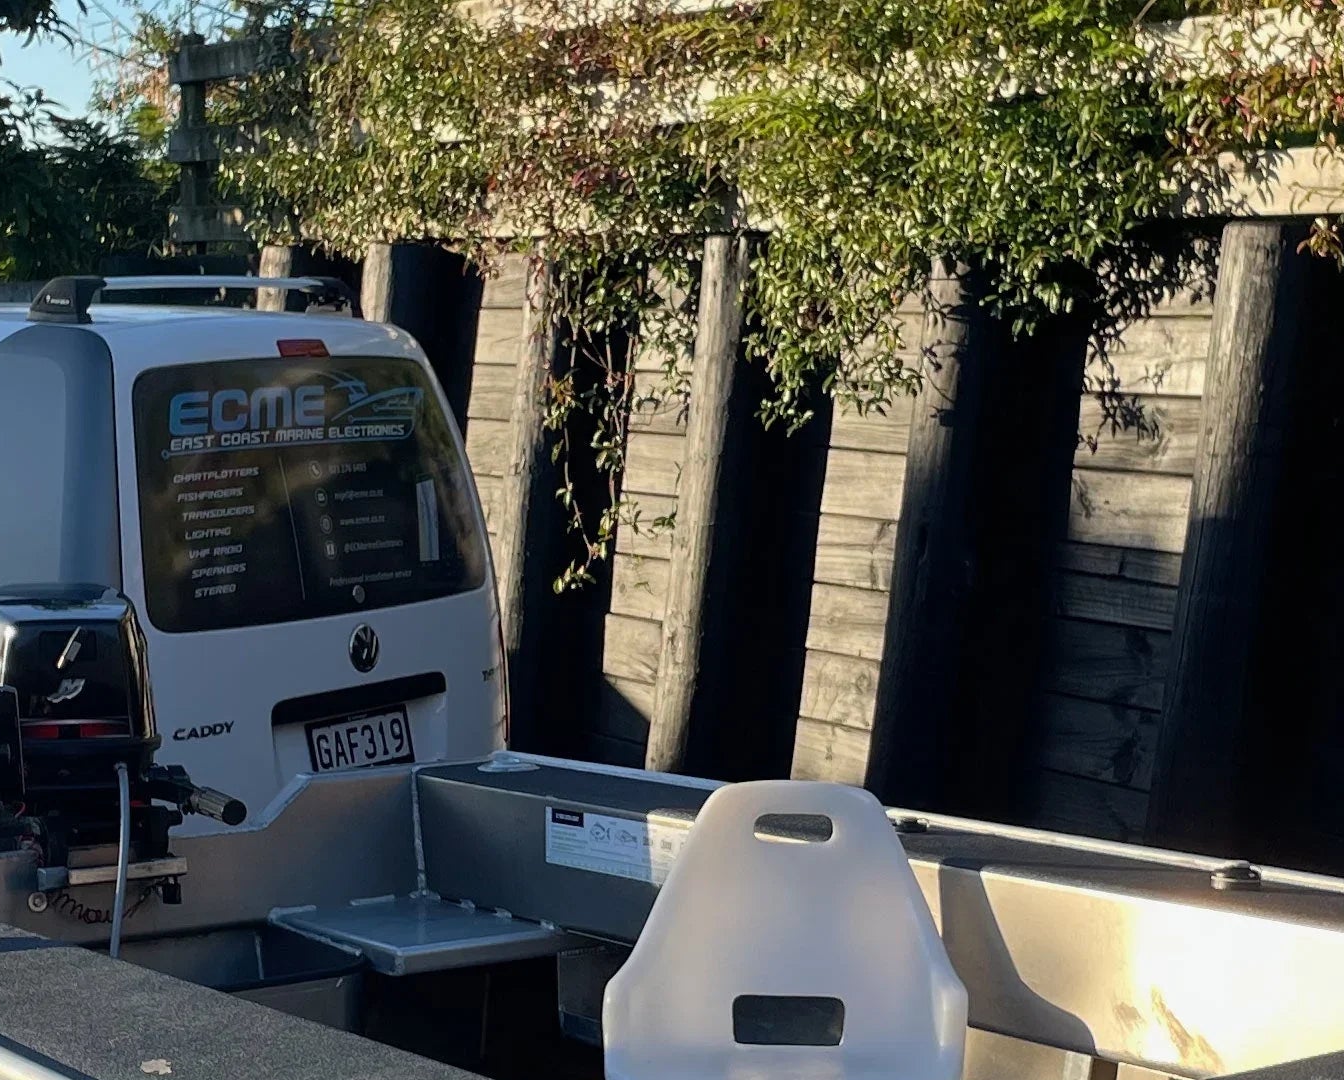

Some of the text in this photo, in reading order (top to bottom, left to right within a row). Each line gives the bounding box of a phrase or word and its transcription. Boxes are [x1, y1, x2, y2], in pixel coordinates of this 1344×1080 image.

[169, 385, 325, 436] ECME
[171, 423, 405, 451] EAST COAST MARINE ELECTRONICS
[182, 505, 256, 521] TRANSDUCERS
[191, 563, 247, 579] SPEAKERS
[194, 584, 237, 598] STEREO
[173, 720, 234, 741] CADDY
[315, 717, 405, 770] GAF319
